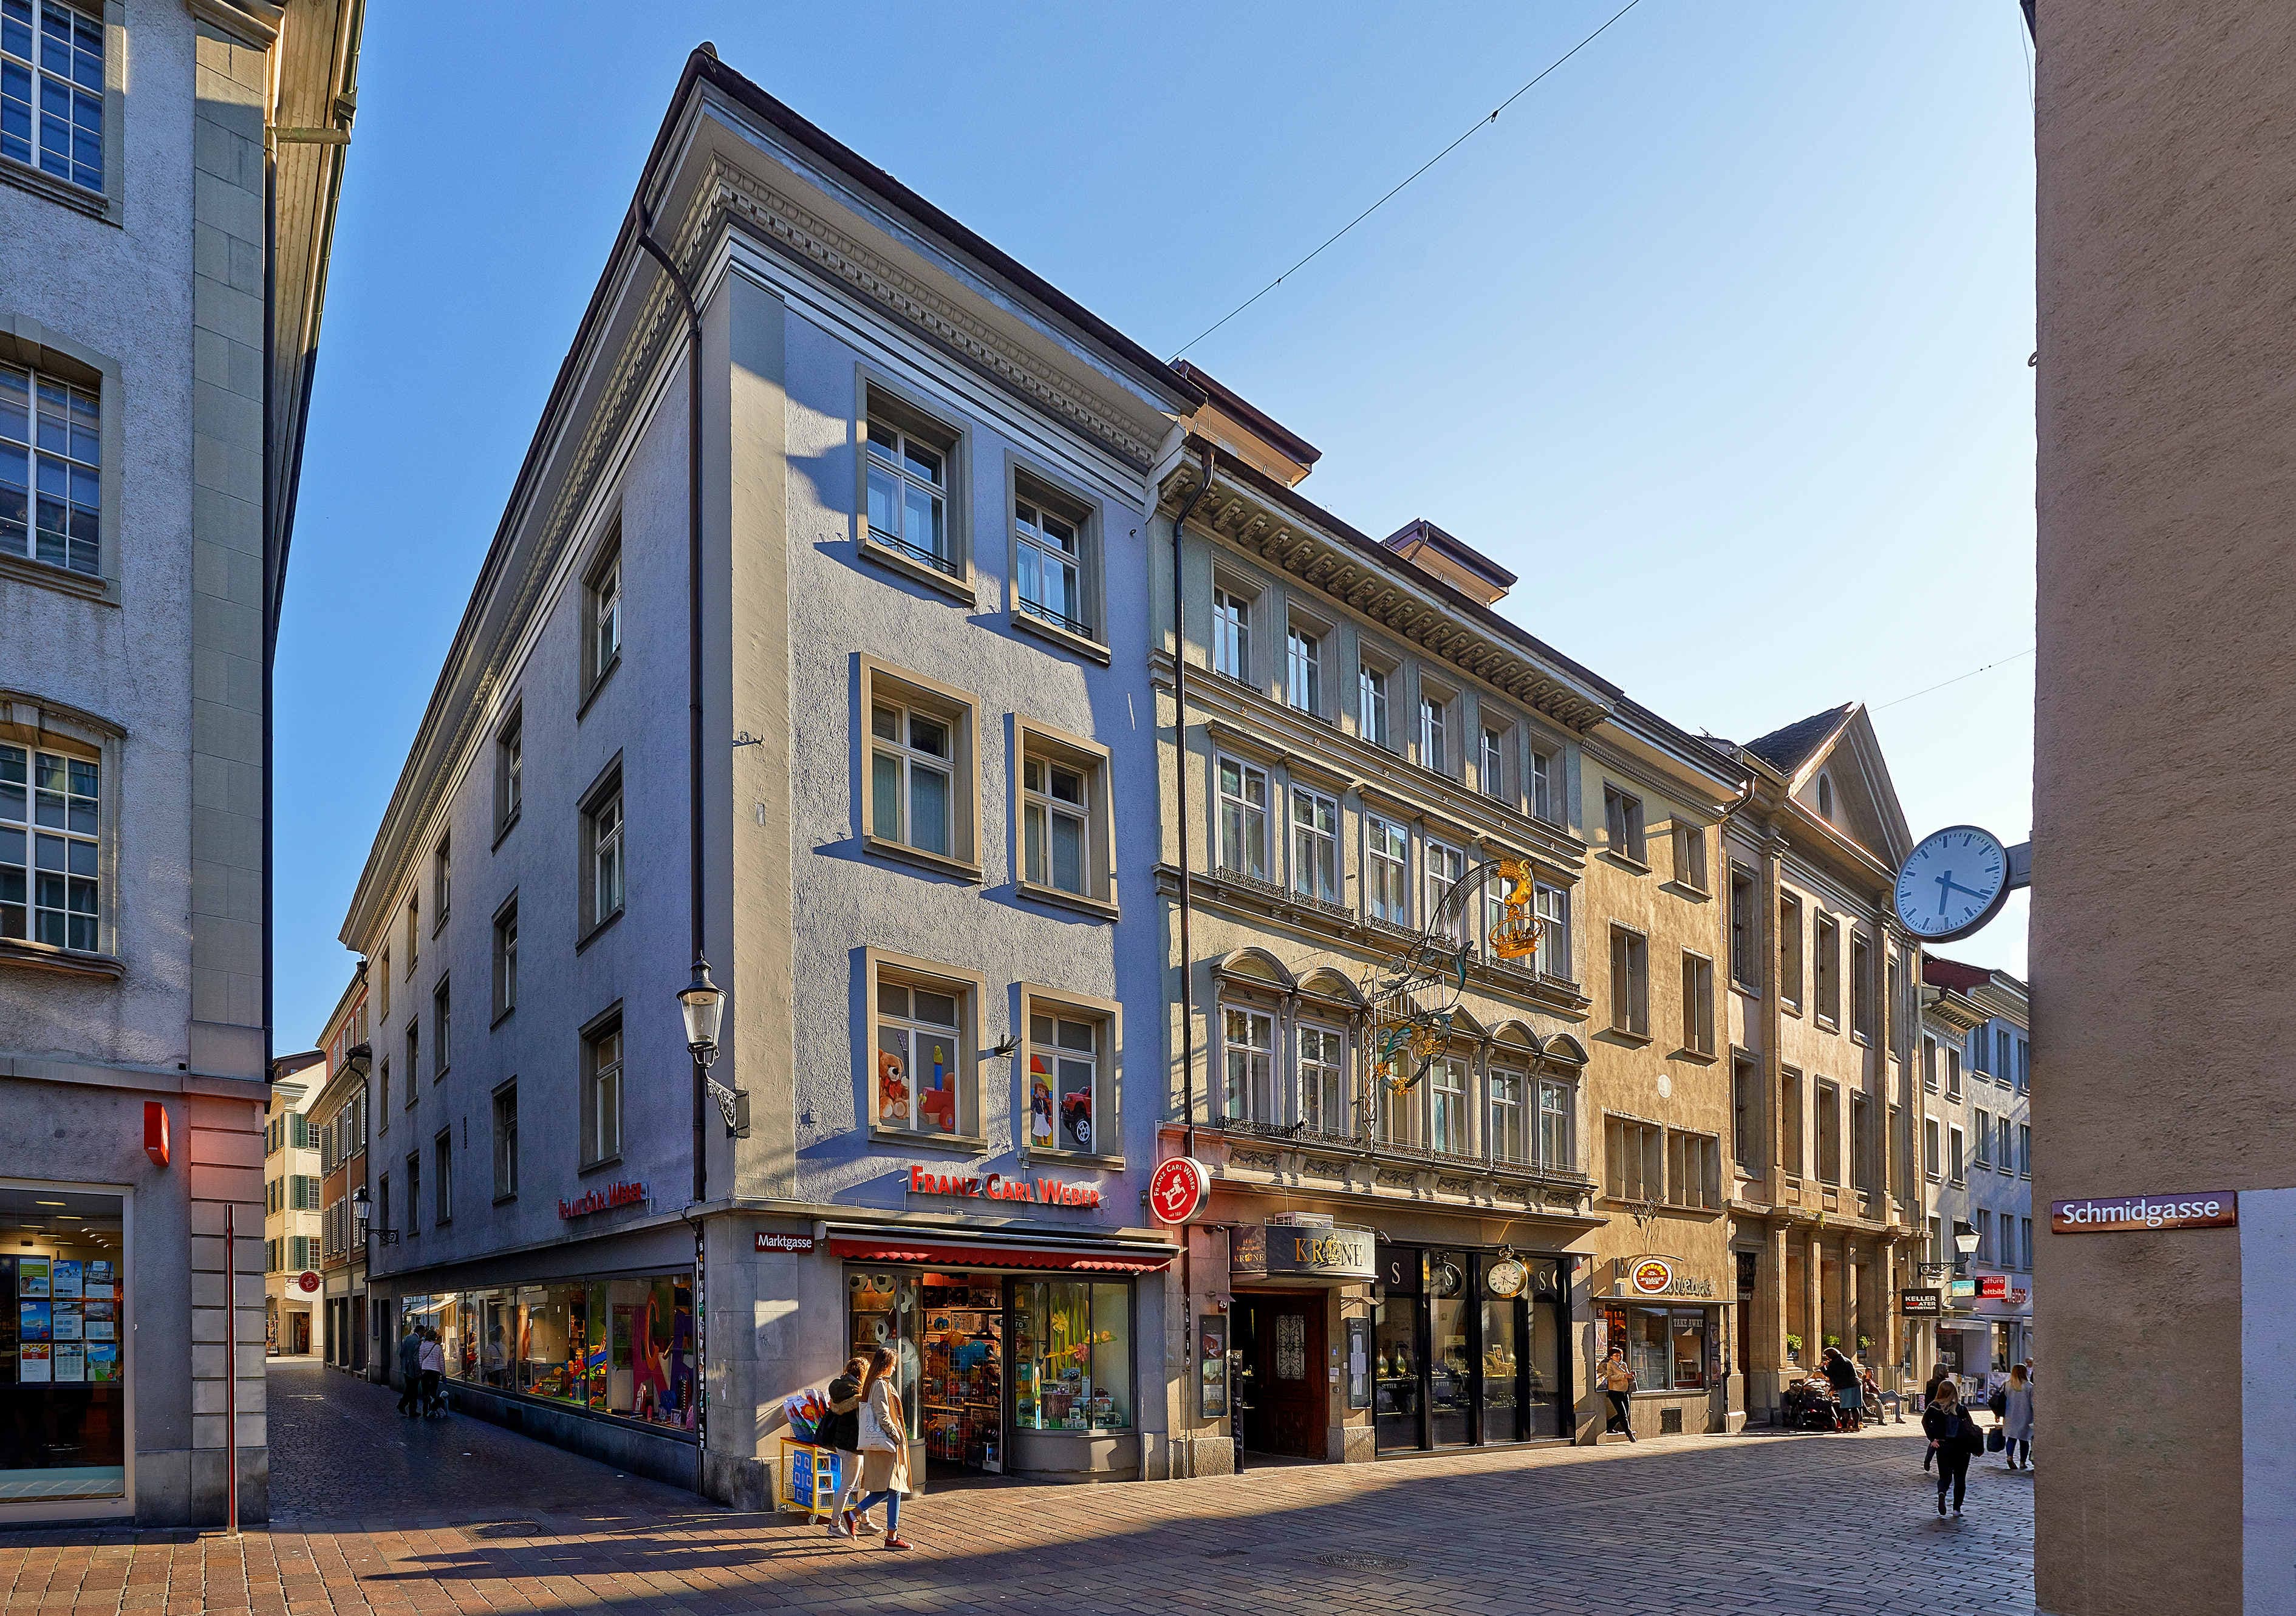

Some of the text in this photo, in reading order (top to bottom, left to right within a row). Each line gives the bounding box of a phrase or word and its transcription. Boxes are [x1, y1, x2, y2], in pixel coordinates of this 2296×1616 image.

[910, 1165, 1100, 1208] FRANZ CARL WEBER
[1154, 1171, 1166, 1196] FRANZ
[1183, 1165, 1195, 1190] WEBER
[608, 1181, 642, 1205] WEBER
[2063, 1199, 2219, 1227] Schmidgasse
[758, 1234, 812, 1250] Marktgasse
[1392, 1262, 1400, 1284] S
[1445, 1265, 1453, 1286] S
[1219, 1300, 1228, 1309] 49
[1673, 1318, 1703, 1328] TAKE AWAY
